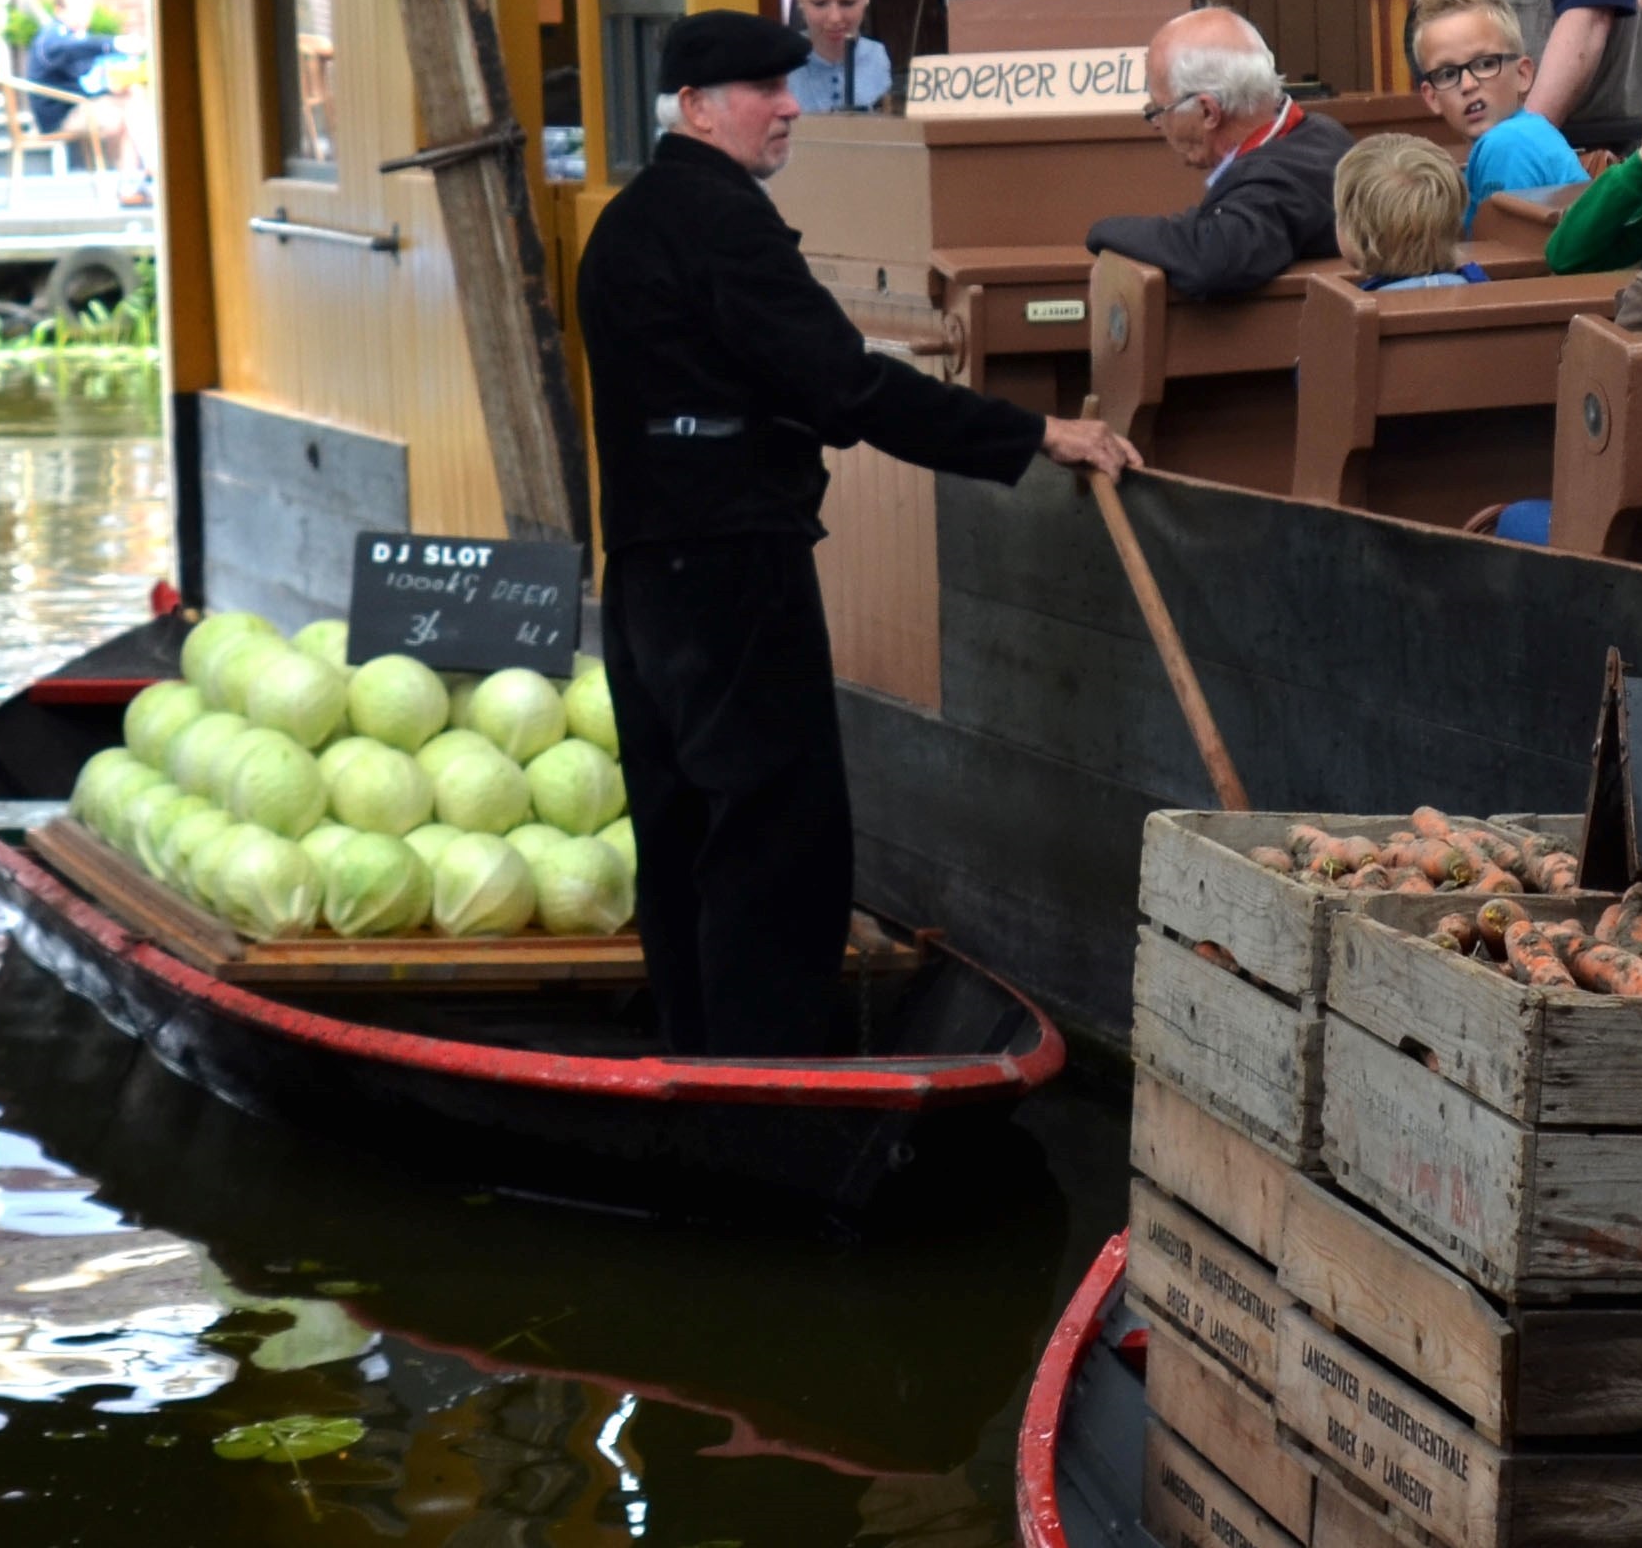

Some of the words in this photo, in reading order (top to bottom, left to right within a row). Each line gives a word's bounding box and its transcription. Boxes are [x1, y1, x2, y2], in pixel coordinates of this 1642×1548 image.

[423, 544, 493, 567] SLOT
[1302, 1341, 1360, 1405] LANGEDYKER
[1367, 1387, 1469, 1482] GROENTENCENTRALE
[1327, 1416, 1358, 1461] BROEK
[1362, 1442, 1375, 1470] OP
[1383, 1454, 1434, 1517] LANGEDYK
